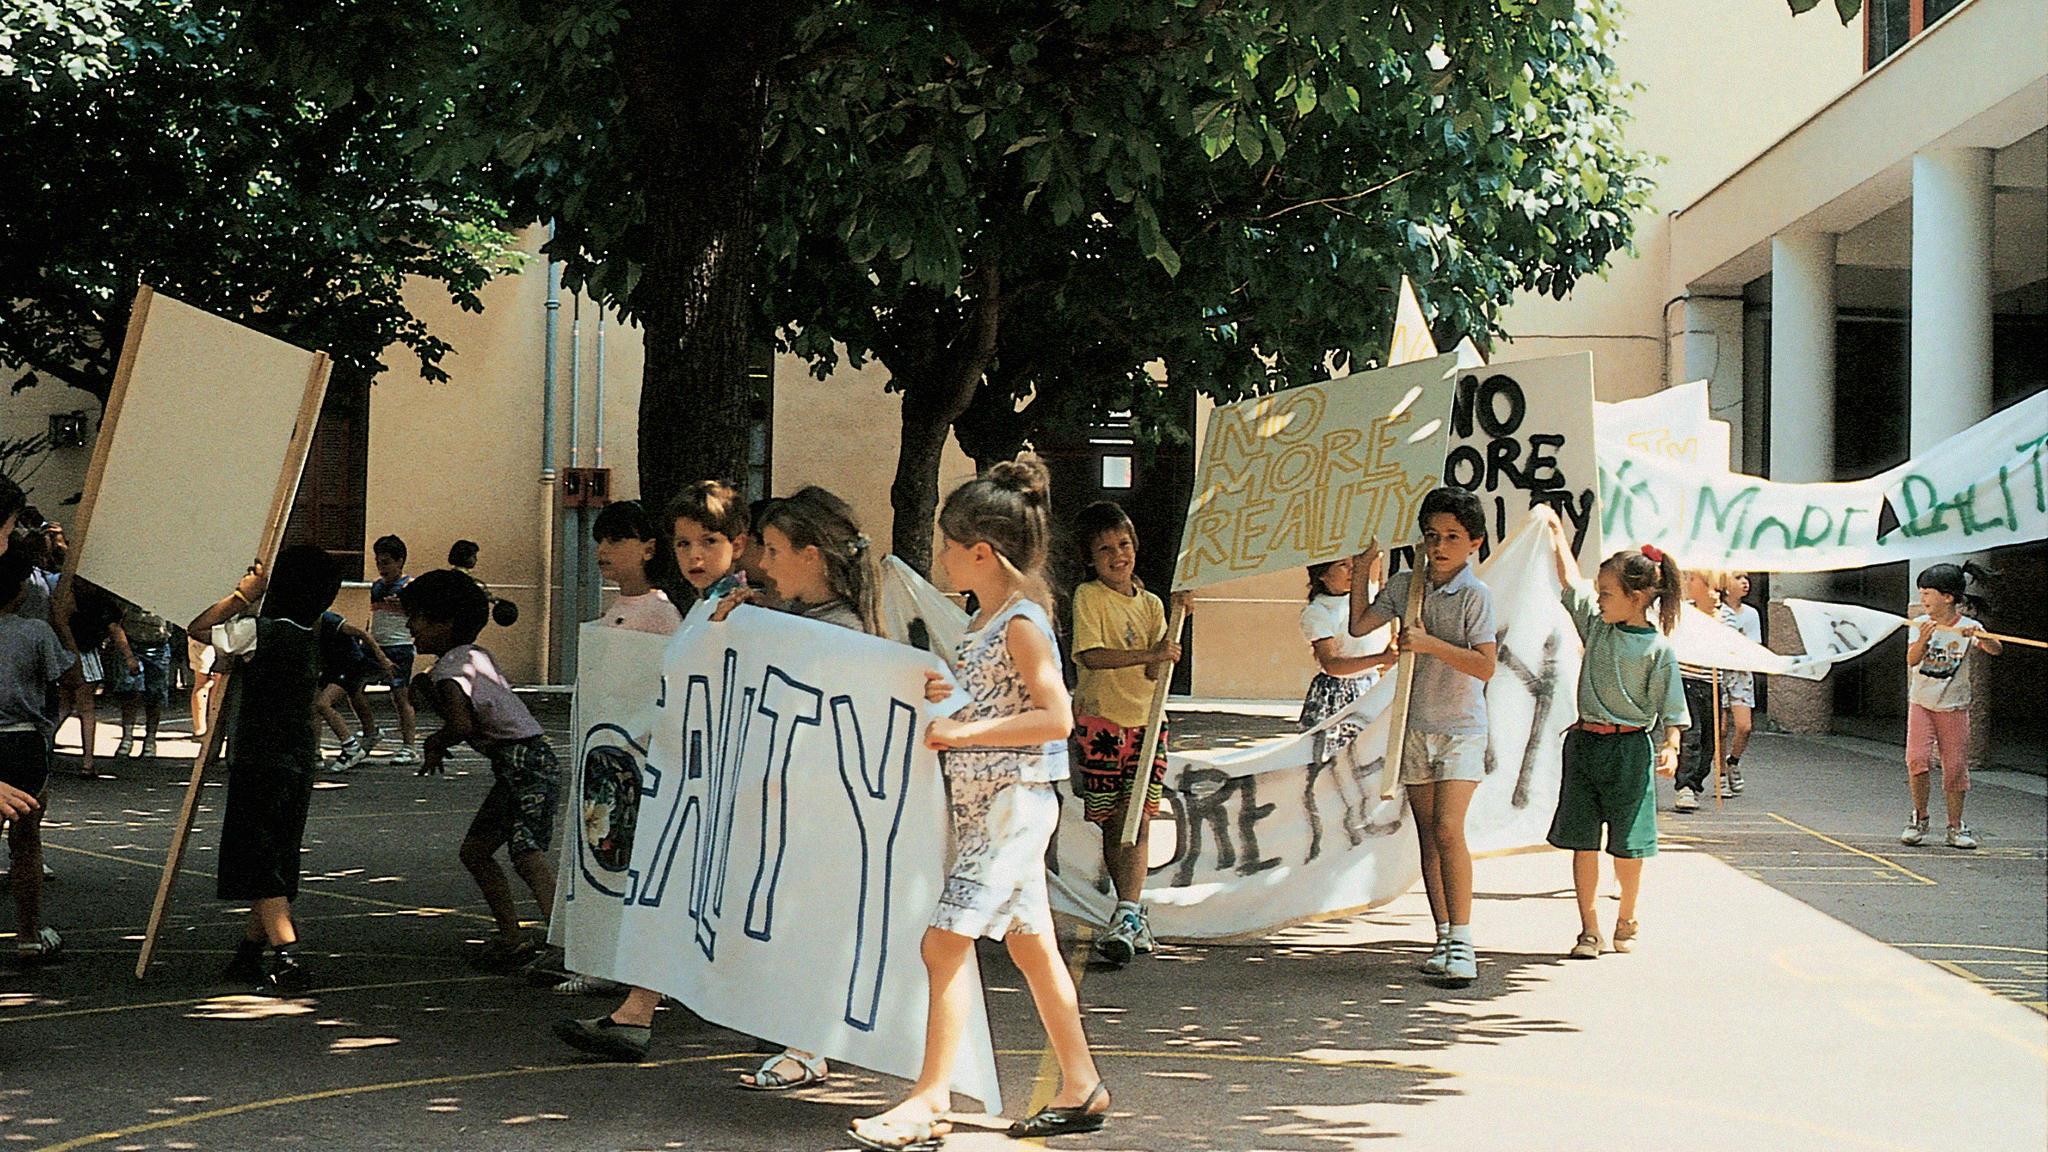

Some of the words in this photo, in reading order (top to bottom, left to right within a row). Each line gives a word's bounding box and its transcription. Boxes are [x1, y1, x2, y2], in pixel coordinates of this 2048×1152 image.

[1201, 411, 1412, 517] MORE
[1209, 386, 1327, 460] NO
[1443, 434, 1566, 492] ORE
[1180, 471, 1438, 582] REALITY
